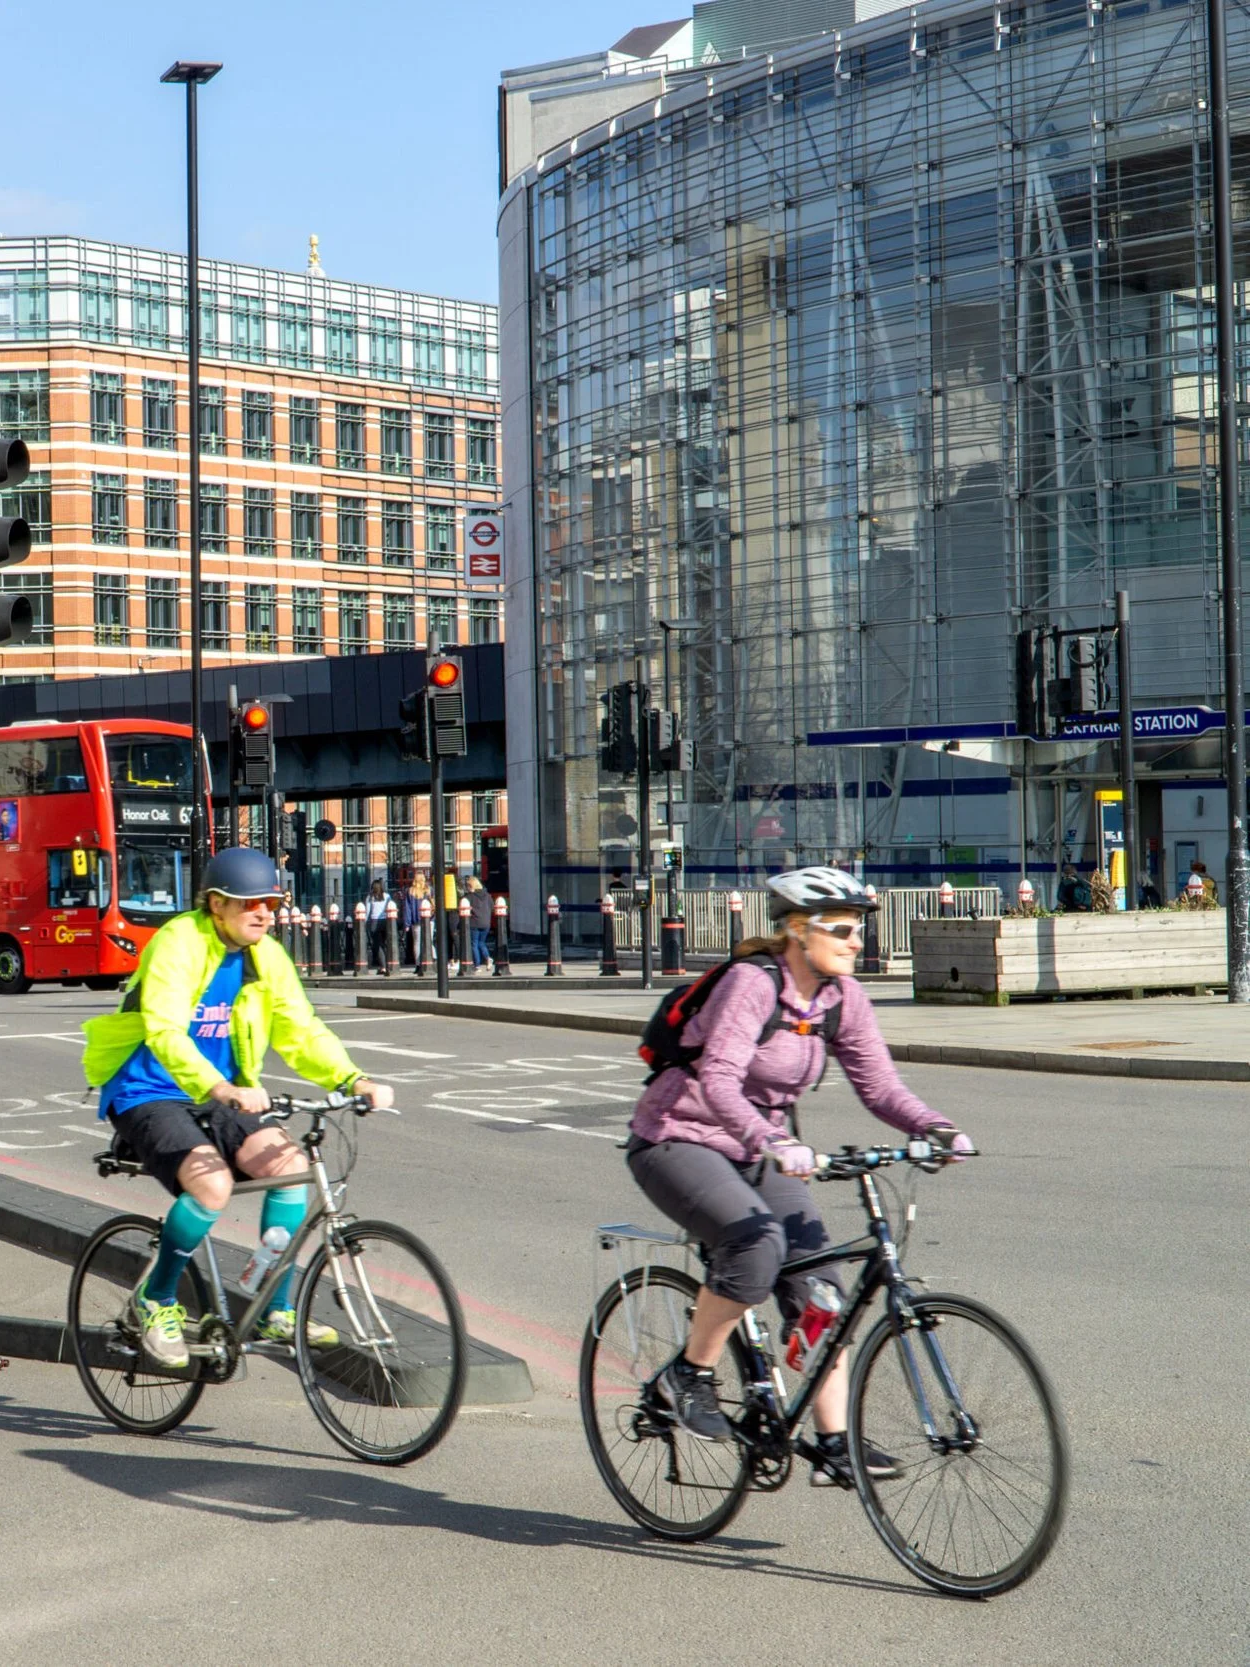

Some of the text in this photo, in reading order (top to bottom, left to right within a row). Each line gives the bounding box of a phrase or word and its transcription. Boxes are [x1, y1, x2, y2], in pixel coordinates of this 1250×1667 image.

[1134, 713, 1198, 732] STATION
[122, 808, 150, 821] Honor
[150, 808, 170, 821] Oak
[55, 924, 75, 943] Go
